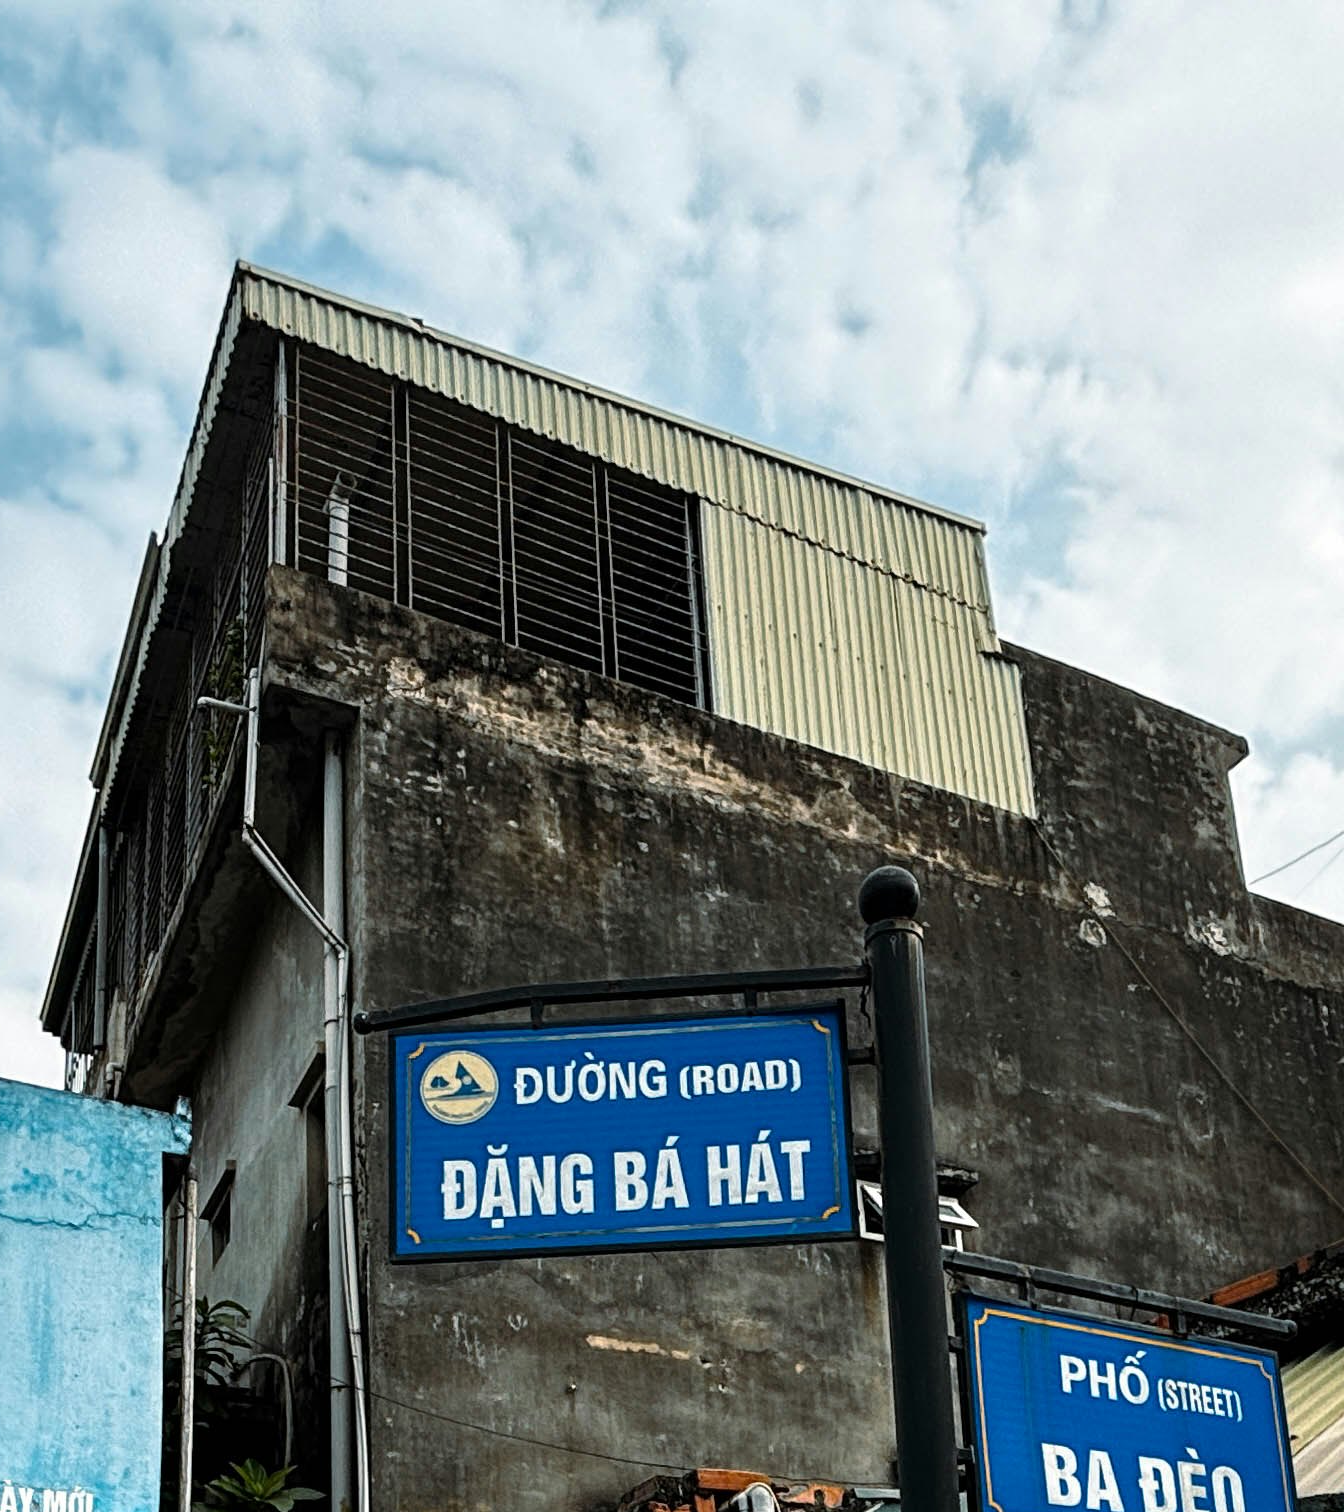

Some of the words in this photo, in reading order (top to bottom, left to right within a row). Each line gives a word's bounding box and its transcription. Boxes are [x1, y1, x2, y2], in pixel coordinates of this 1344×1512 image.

[514, 1052, 668, 1105] ĐƯỜNG
[679, 1058, 802, 1100] (ROAD)
[441, 1144, 595, 1229] ĐẶNG
[614, 1135, 690, 1212] BÁ
[706, 1129, 811, 1207] HÁT
[1059, 1350, 1150, 1405] PHỐ
[1157, 1378, 1243, 1422] (STREET)
